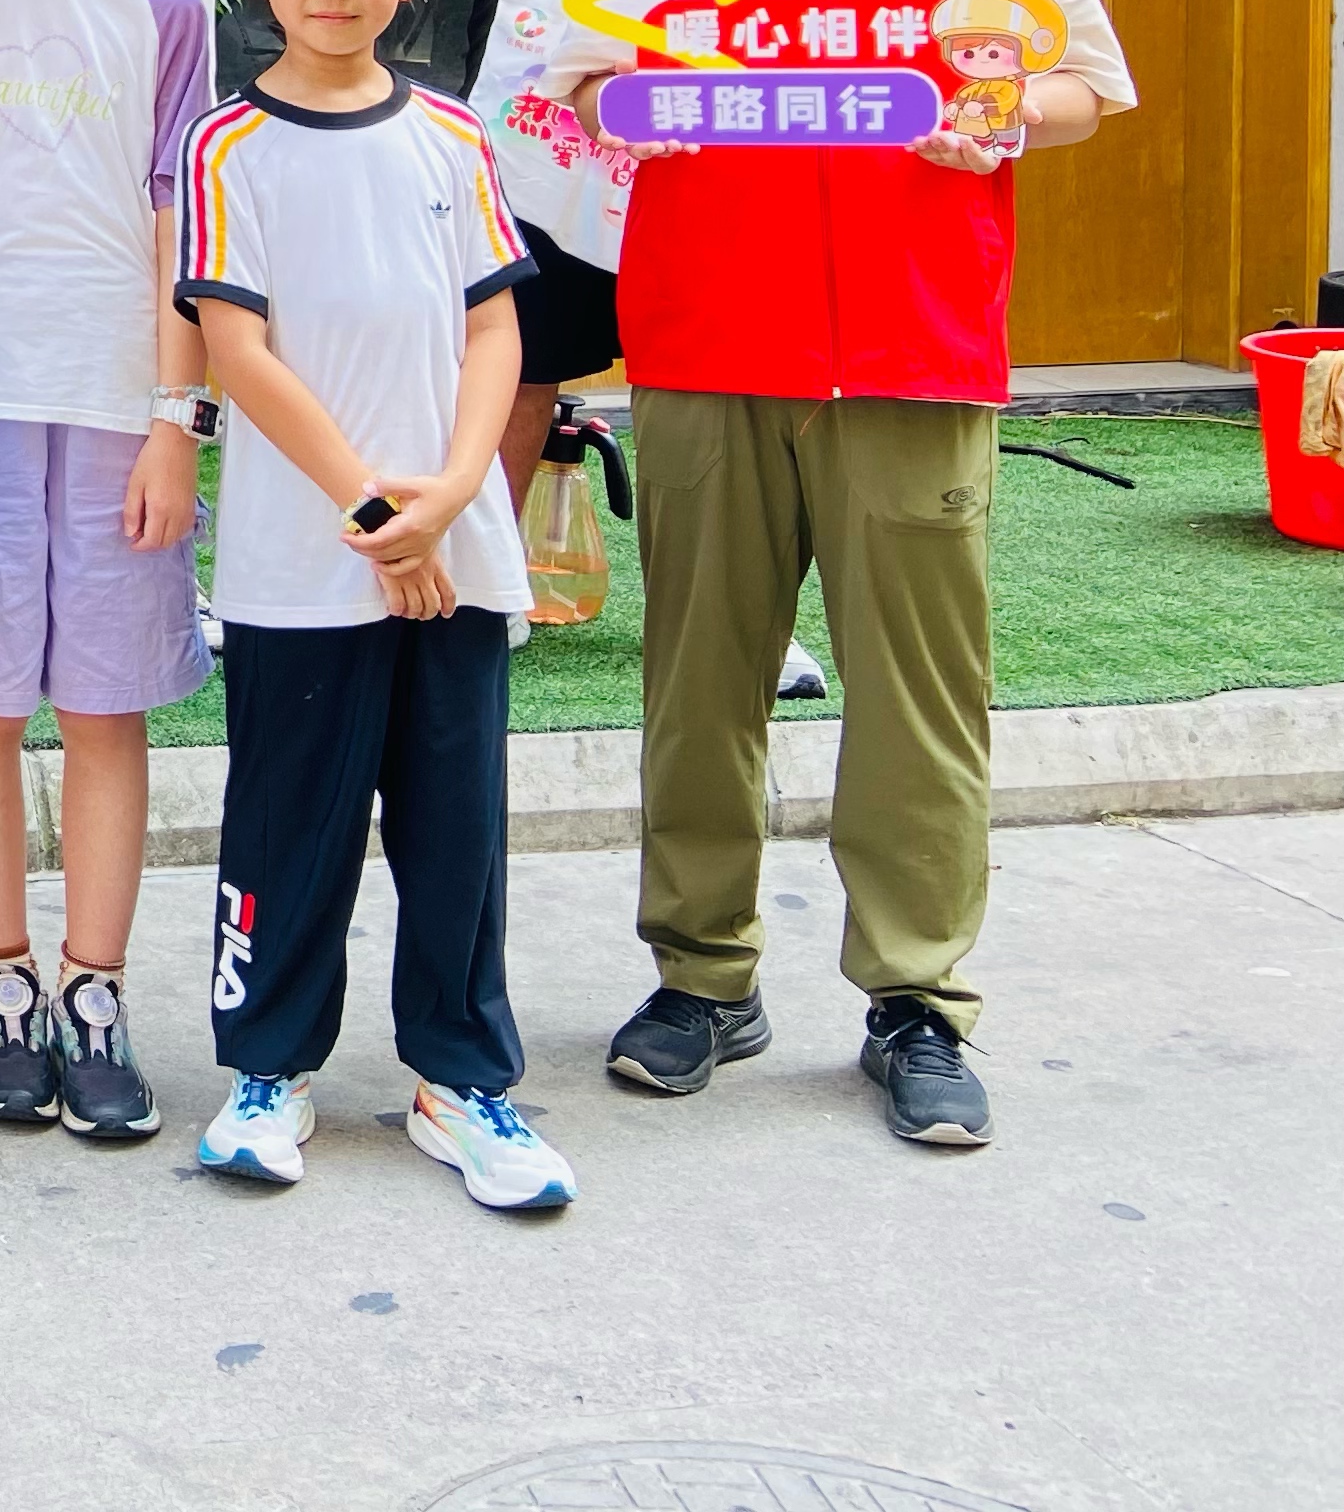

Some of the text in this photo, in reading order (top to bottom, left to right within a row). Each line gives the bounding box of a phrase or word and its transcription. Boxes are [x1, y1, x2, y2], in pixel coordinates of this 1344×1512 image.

[664, 5, 929, 61] 暖心相伴
[649, 84, 893, 133] 驿路同行
[213, 881, 256, 1010] FILA
